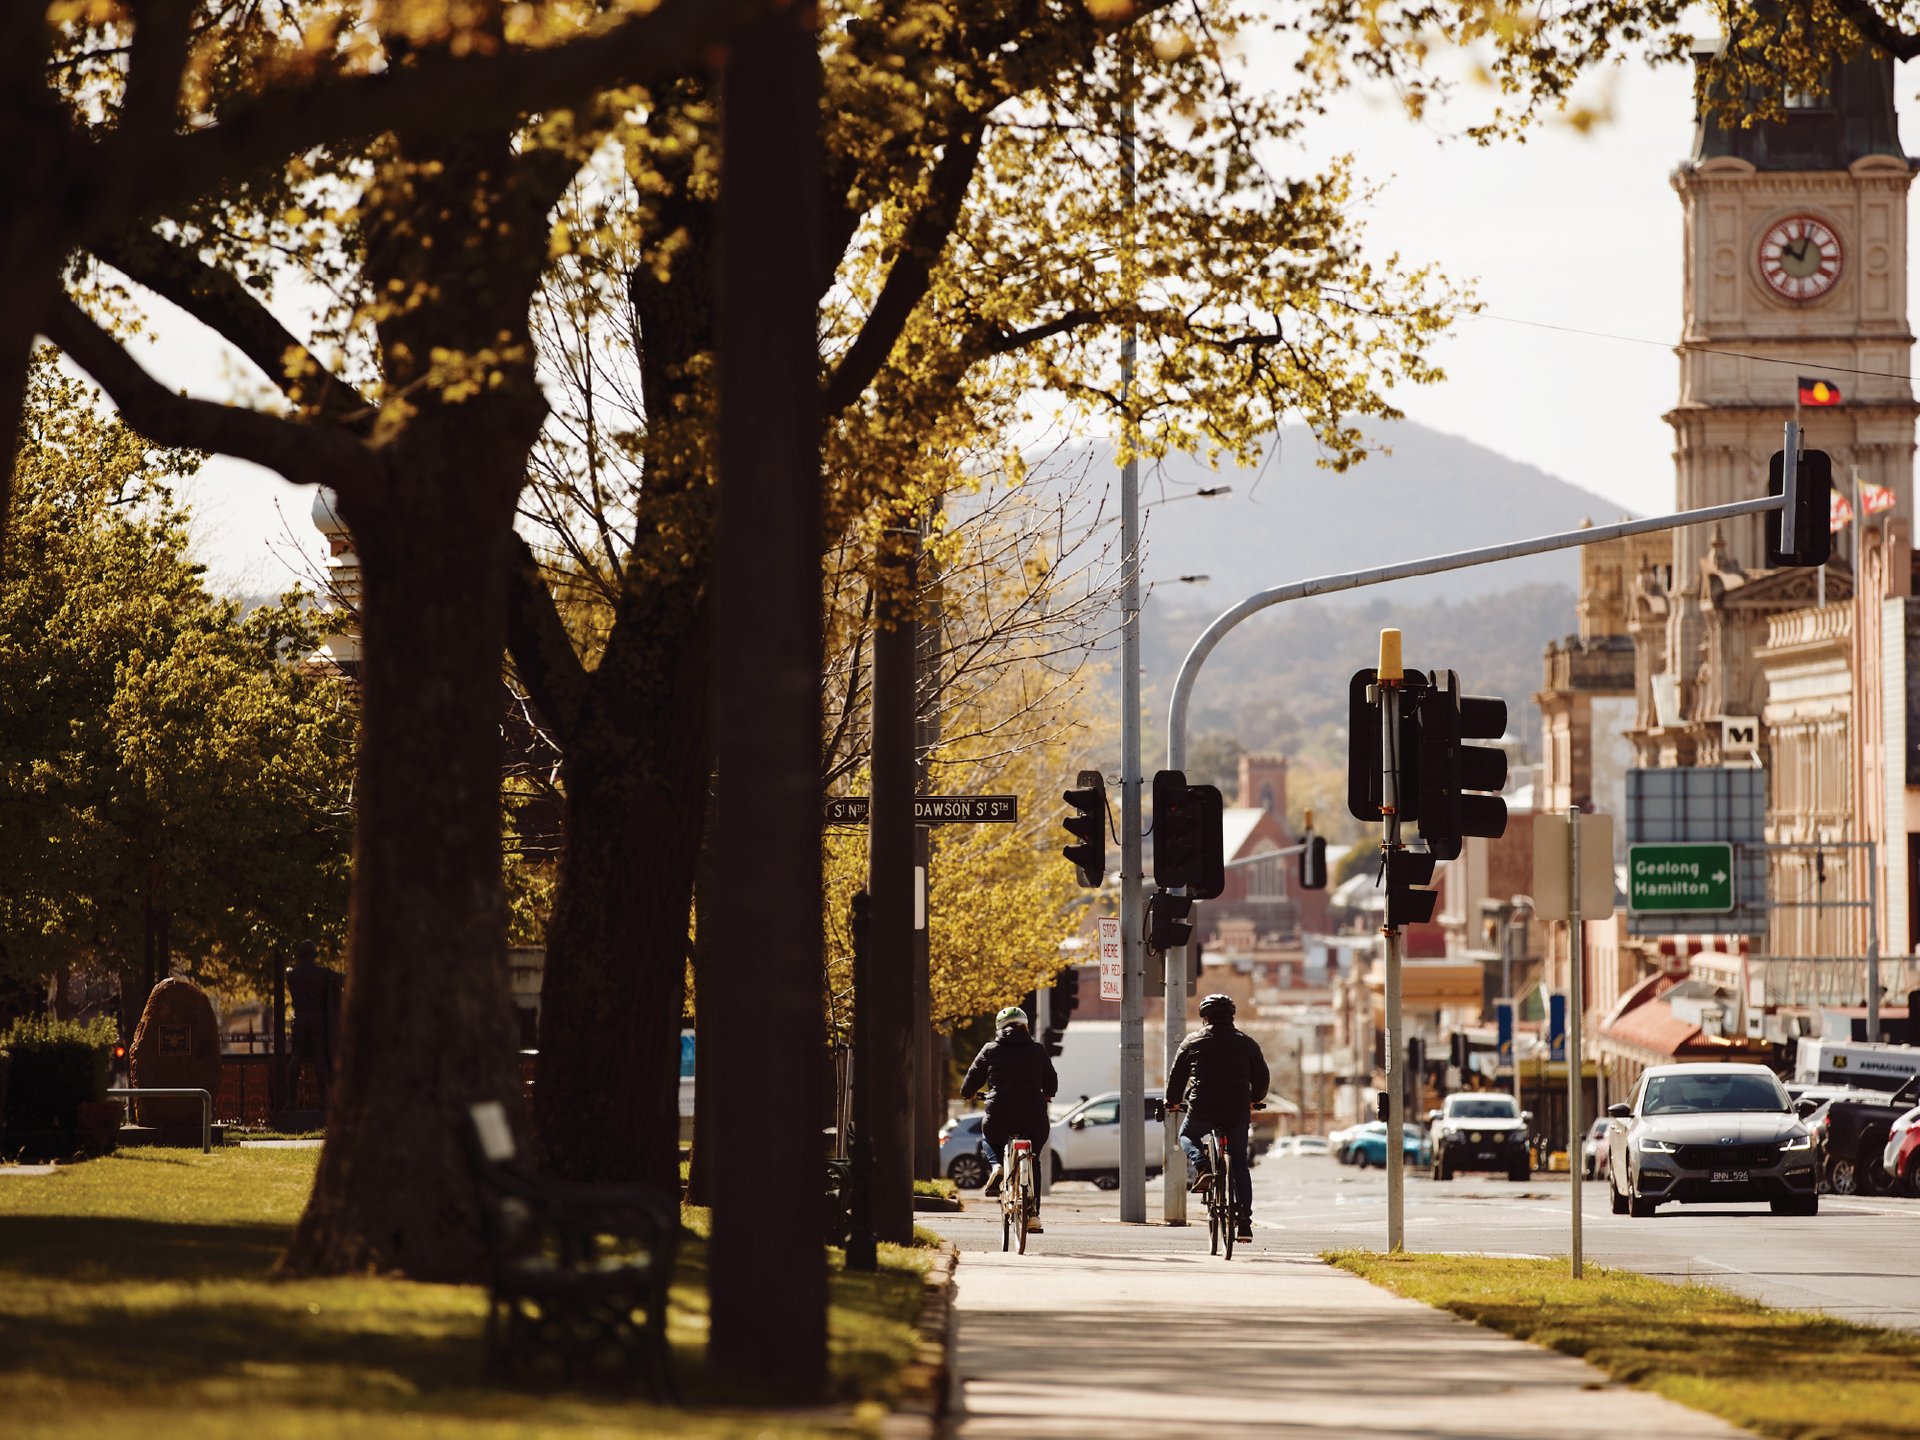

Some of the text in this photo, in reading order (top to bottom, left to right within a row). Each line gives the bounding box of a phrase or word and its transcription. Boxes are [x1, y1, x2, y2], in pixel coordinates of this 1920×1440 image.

[1729, 727, 1753, 742] M
[914, 803, 970, 816] DAWSON
[1636, 861, 1699, 878] Geelong
[1635, 881, 1709, 896] Hamilton
[1102, 923, 1117, 938] STOP
[1103, 943, 1118, 958] HERE
[1101, 963, 1120, 976] ON RED
[1103, 981, 1119, 994] SIGNAL
[1713, 1171, 1749, 1180] BNN 596
